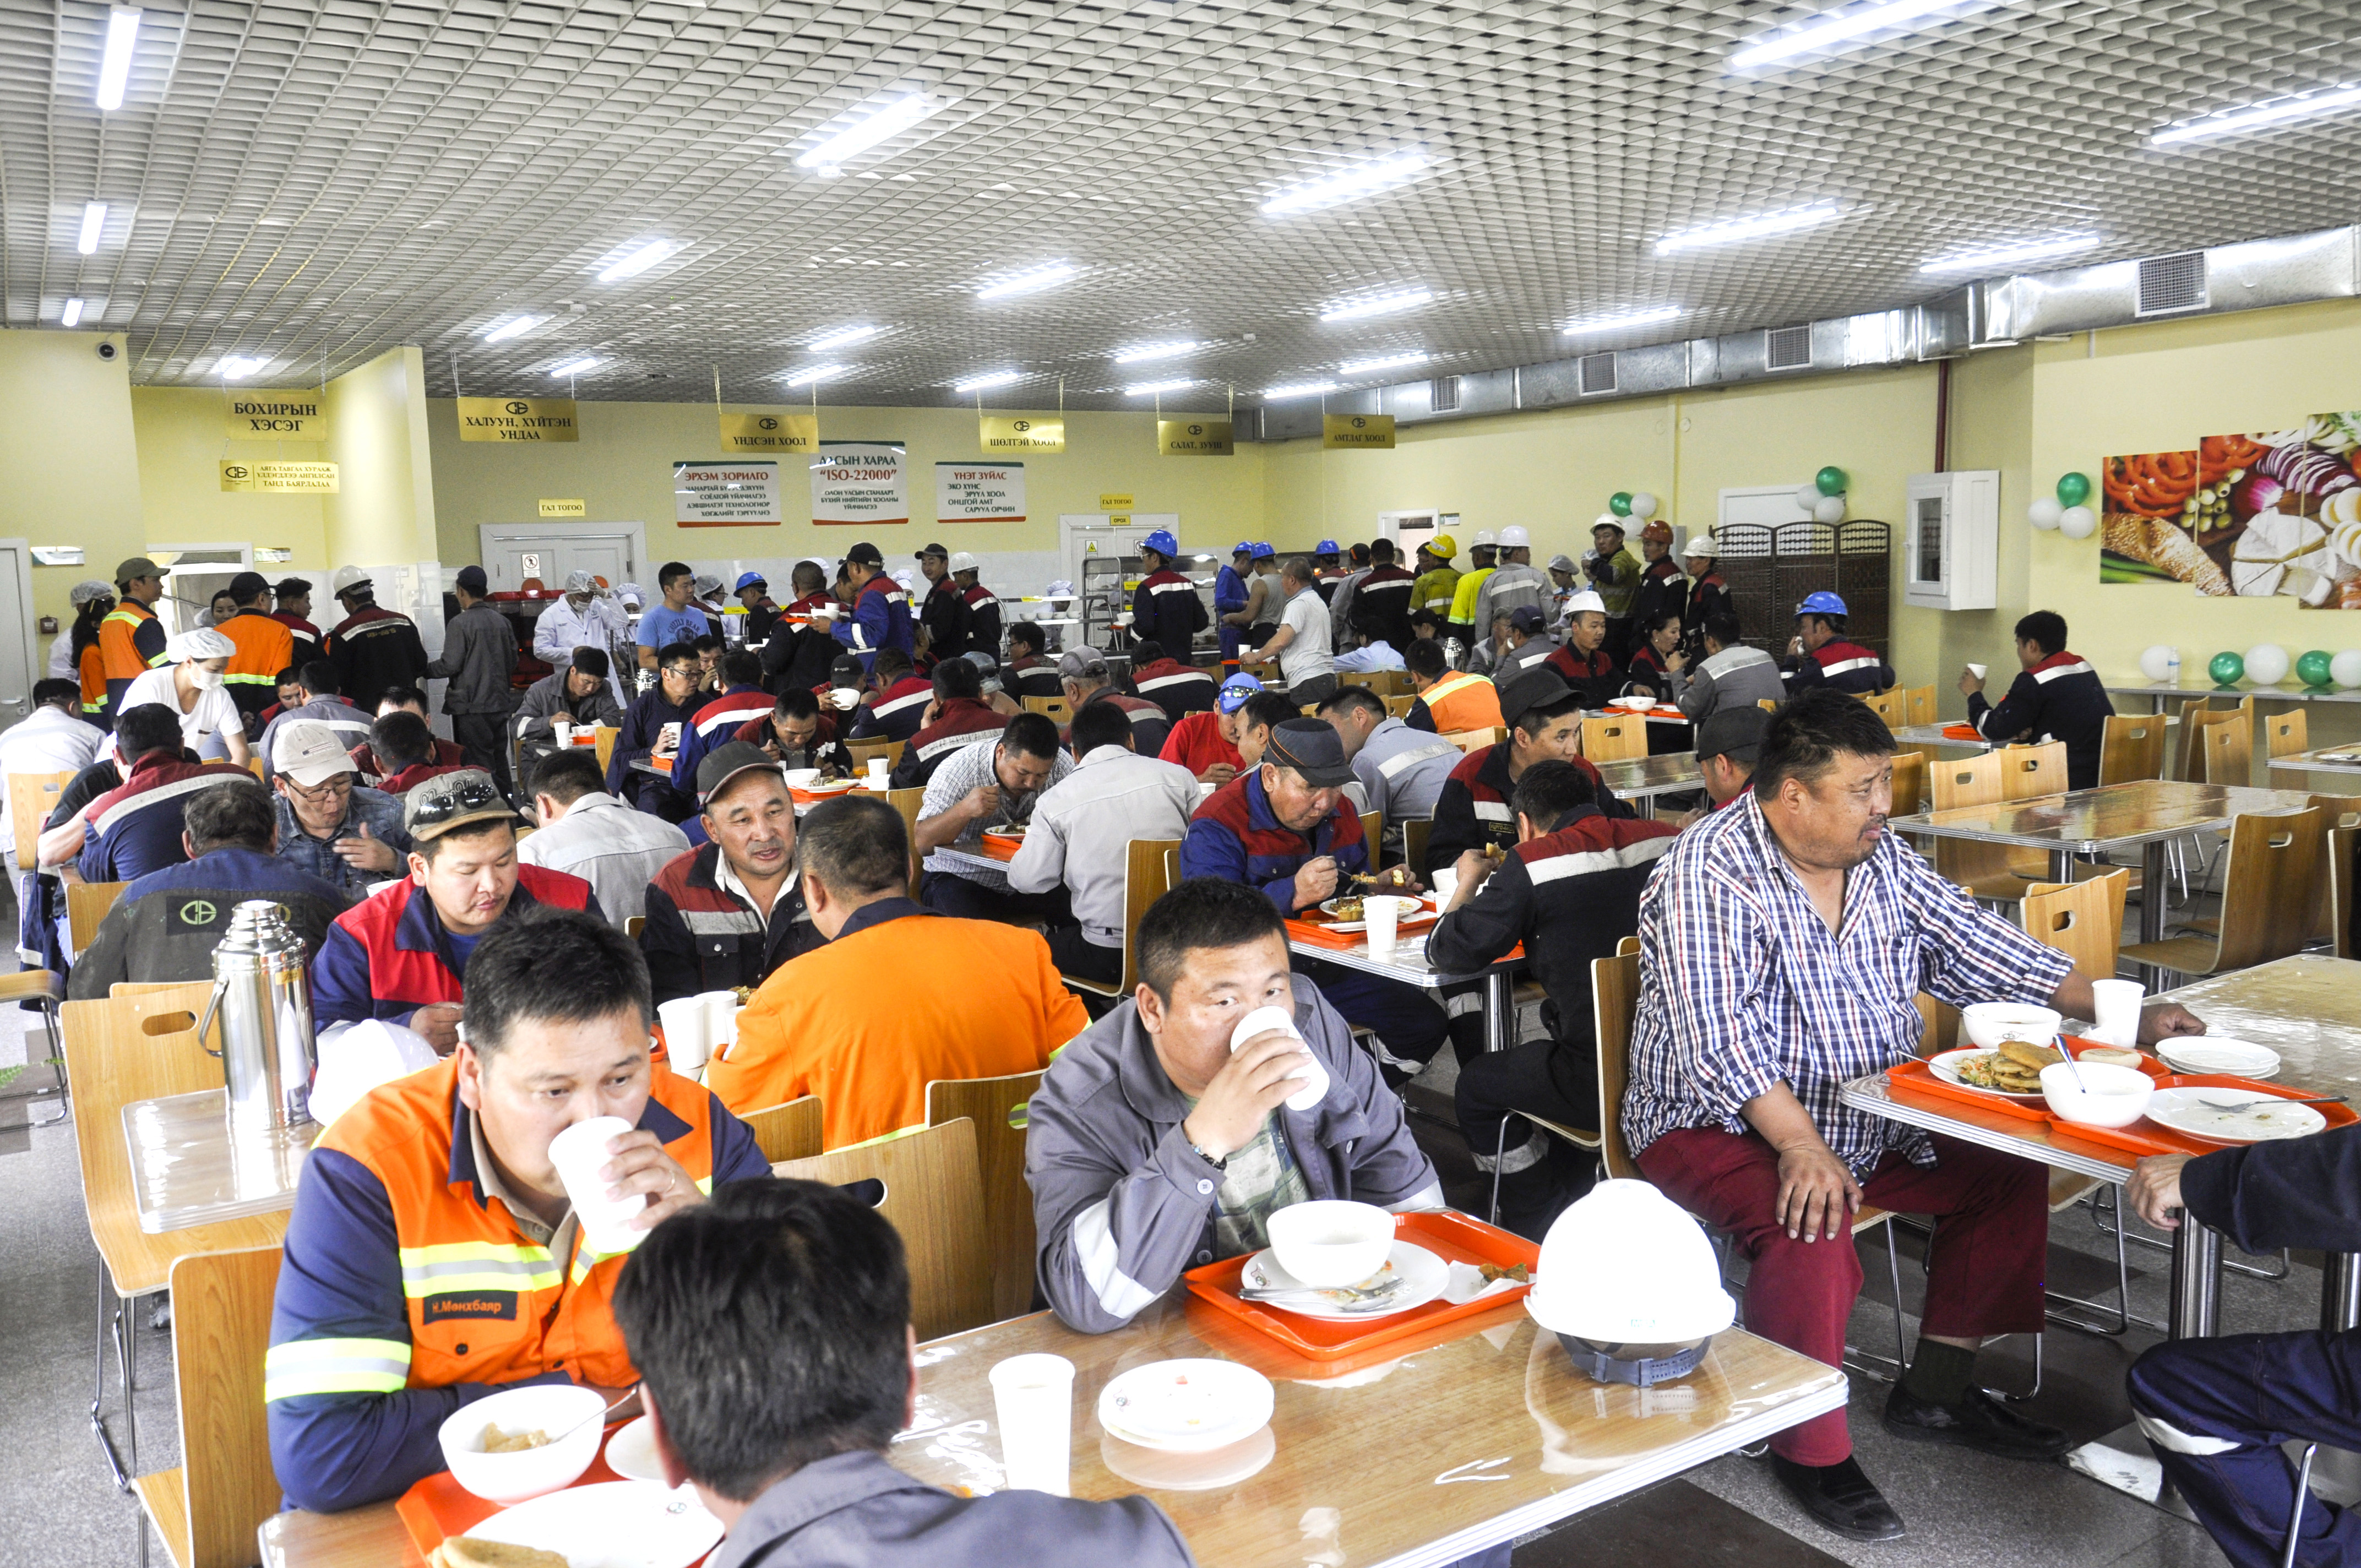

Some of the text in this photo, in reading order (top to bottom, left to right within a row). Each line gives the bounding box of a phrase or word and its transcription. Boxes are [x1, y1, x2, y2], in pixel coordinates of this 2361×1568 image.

[233, 402, 317, 416] БОХИРЫН
[249, 419, 303, 431] ХЭСЭГ
[466, 416, 571, 428] ХАЛУУН, ХҮЙТЭН
[499, 430, 540, 440] УНДАА
[733, 437, 775, 445] ҮНДСЭН
[990, 437, 1029, 446] ШӨЛТЭЙ
[864, 456, 896, 465] ХАРАА
[685, 472, 768, 481] ЭРХЭМ ЗОРИЛГО
[978, 471, 1007, 480] ЗҮЙЛС
